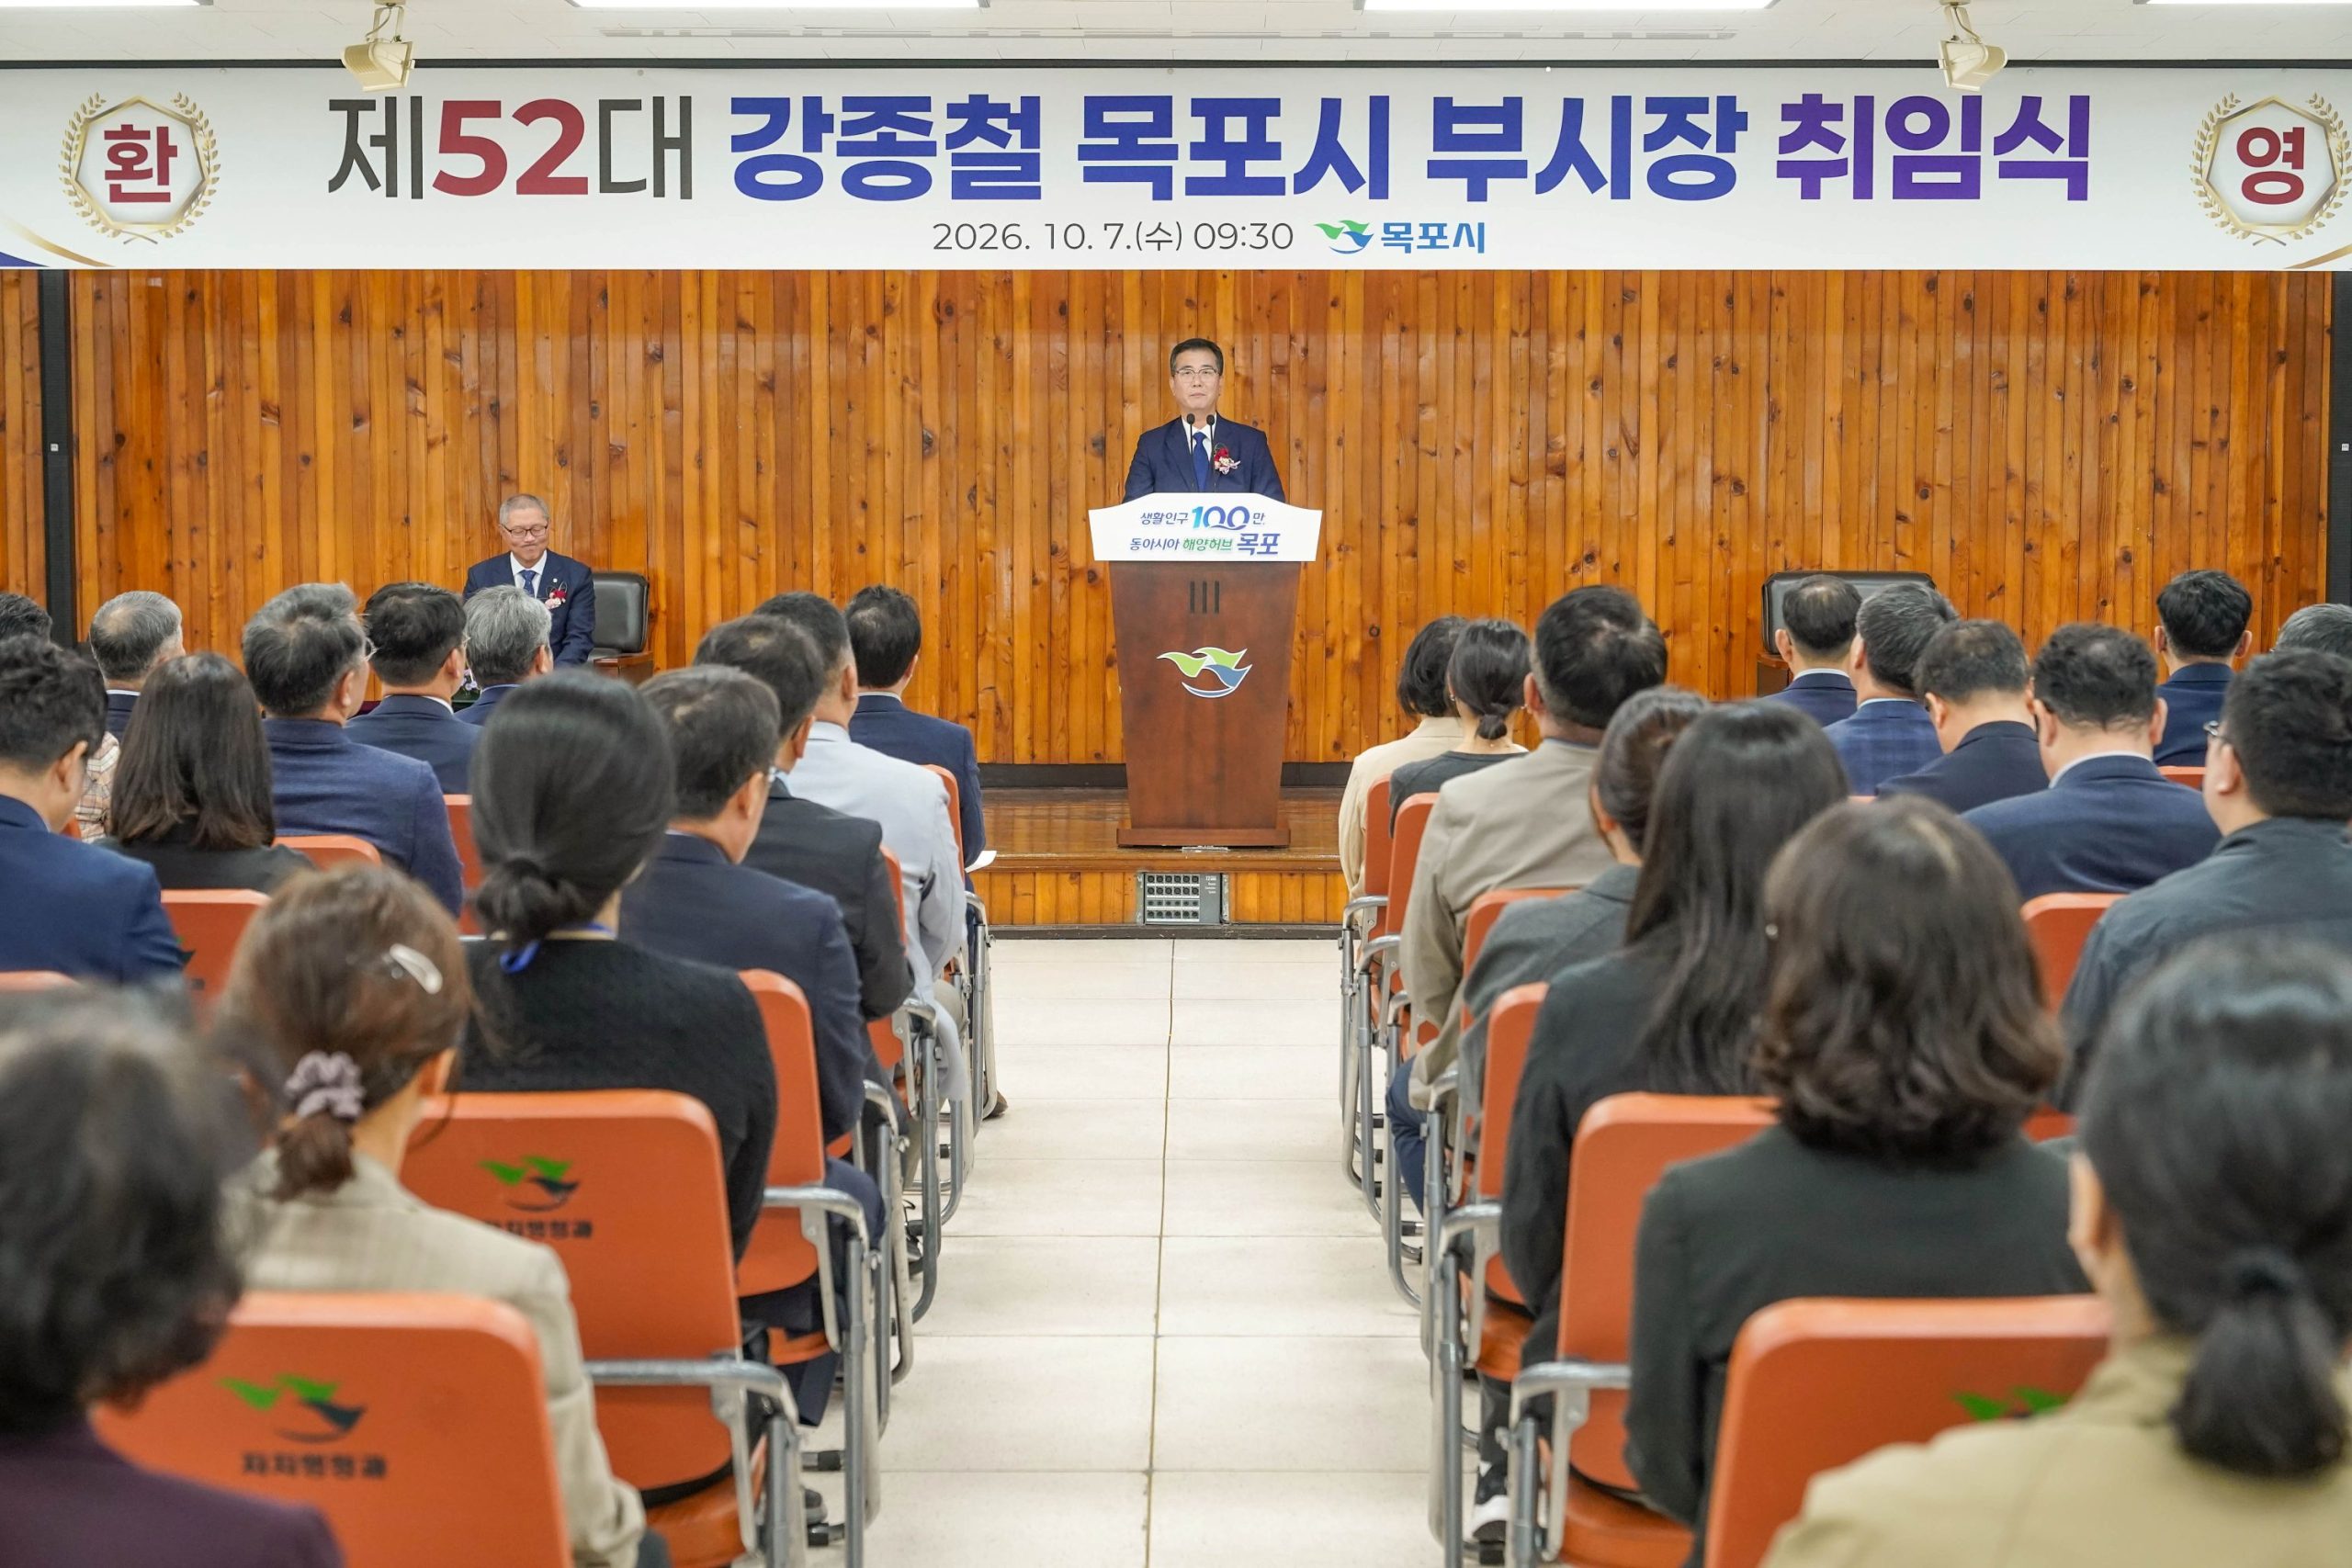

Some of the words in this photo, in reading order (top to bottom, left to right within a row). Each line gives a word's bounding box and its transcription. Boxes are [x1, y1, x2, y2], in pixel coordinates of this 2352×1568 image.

[103, 124, 178, 203] 환
[328, 96, 693, 200] 제52대
[730, 95, 1042, 201] 강종철
[1077, 96, 1390, 201] 목포시
[1426, 96, 1748, 201] 부시장
[1776, 94, 2091, 201] 취임식
[2235, 127, 2305, 205] 영
[933, 222, 1030, 250] 2026.
[1045, 222, 1092, 250] 10.
[1103, 221, 1182, 252] 7.(수)
[1193, 222, 1294, 250] 09:30
[1381, 221, 1485, 254] 목포시
[1140, 512, 1189, 525] 생활인구
[1129, 537, 1181, 551] 동아시아
[1182, 537, 1233, 552] 해양허브
[1237, 533, 1281, 557] 목포
